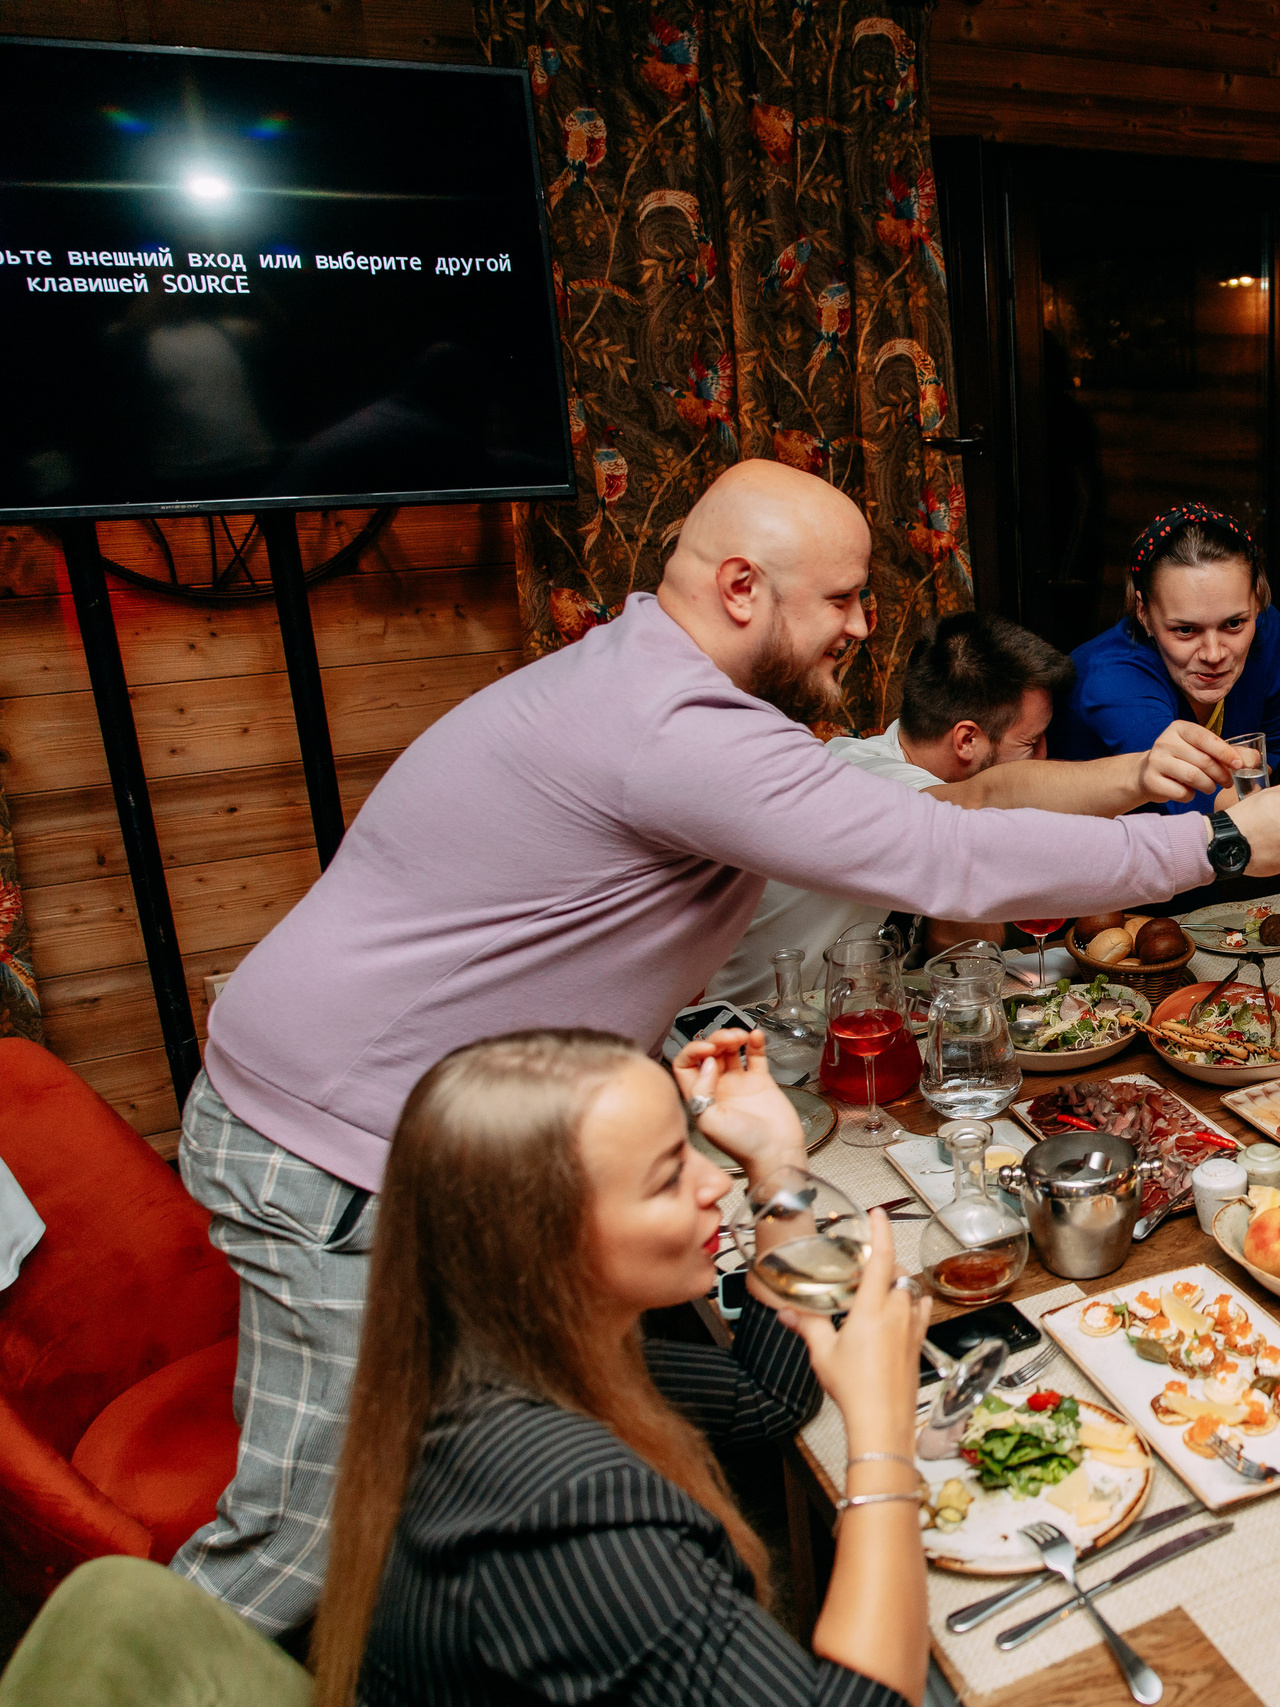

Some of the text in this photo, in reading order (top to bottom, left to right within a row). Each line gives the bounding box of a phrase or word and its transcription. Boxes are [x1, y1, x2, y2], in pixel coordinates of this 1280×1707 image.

[67, 247, 174, 267] внешний
[187, 252, 247, 272] вход
[259, 254, 302, 269] или
[315, 251, 422, 275] выберите
[435, 253, 512, 276] другой
[26, 273, 251, 294] клавишей SOURCE
